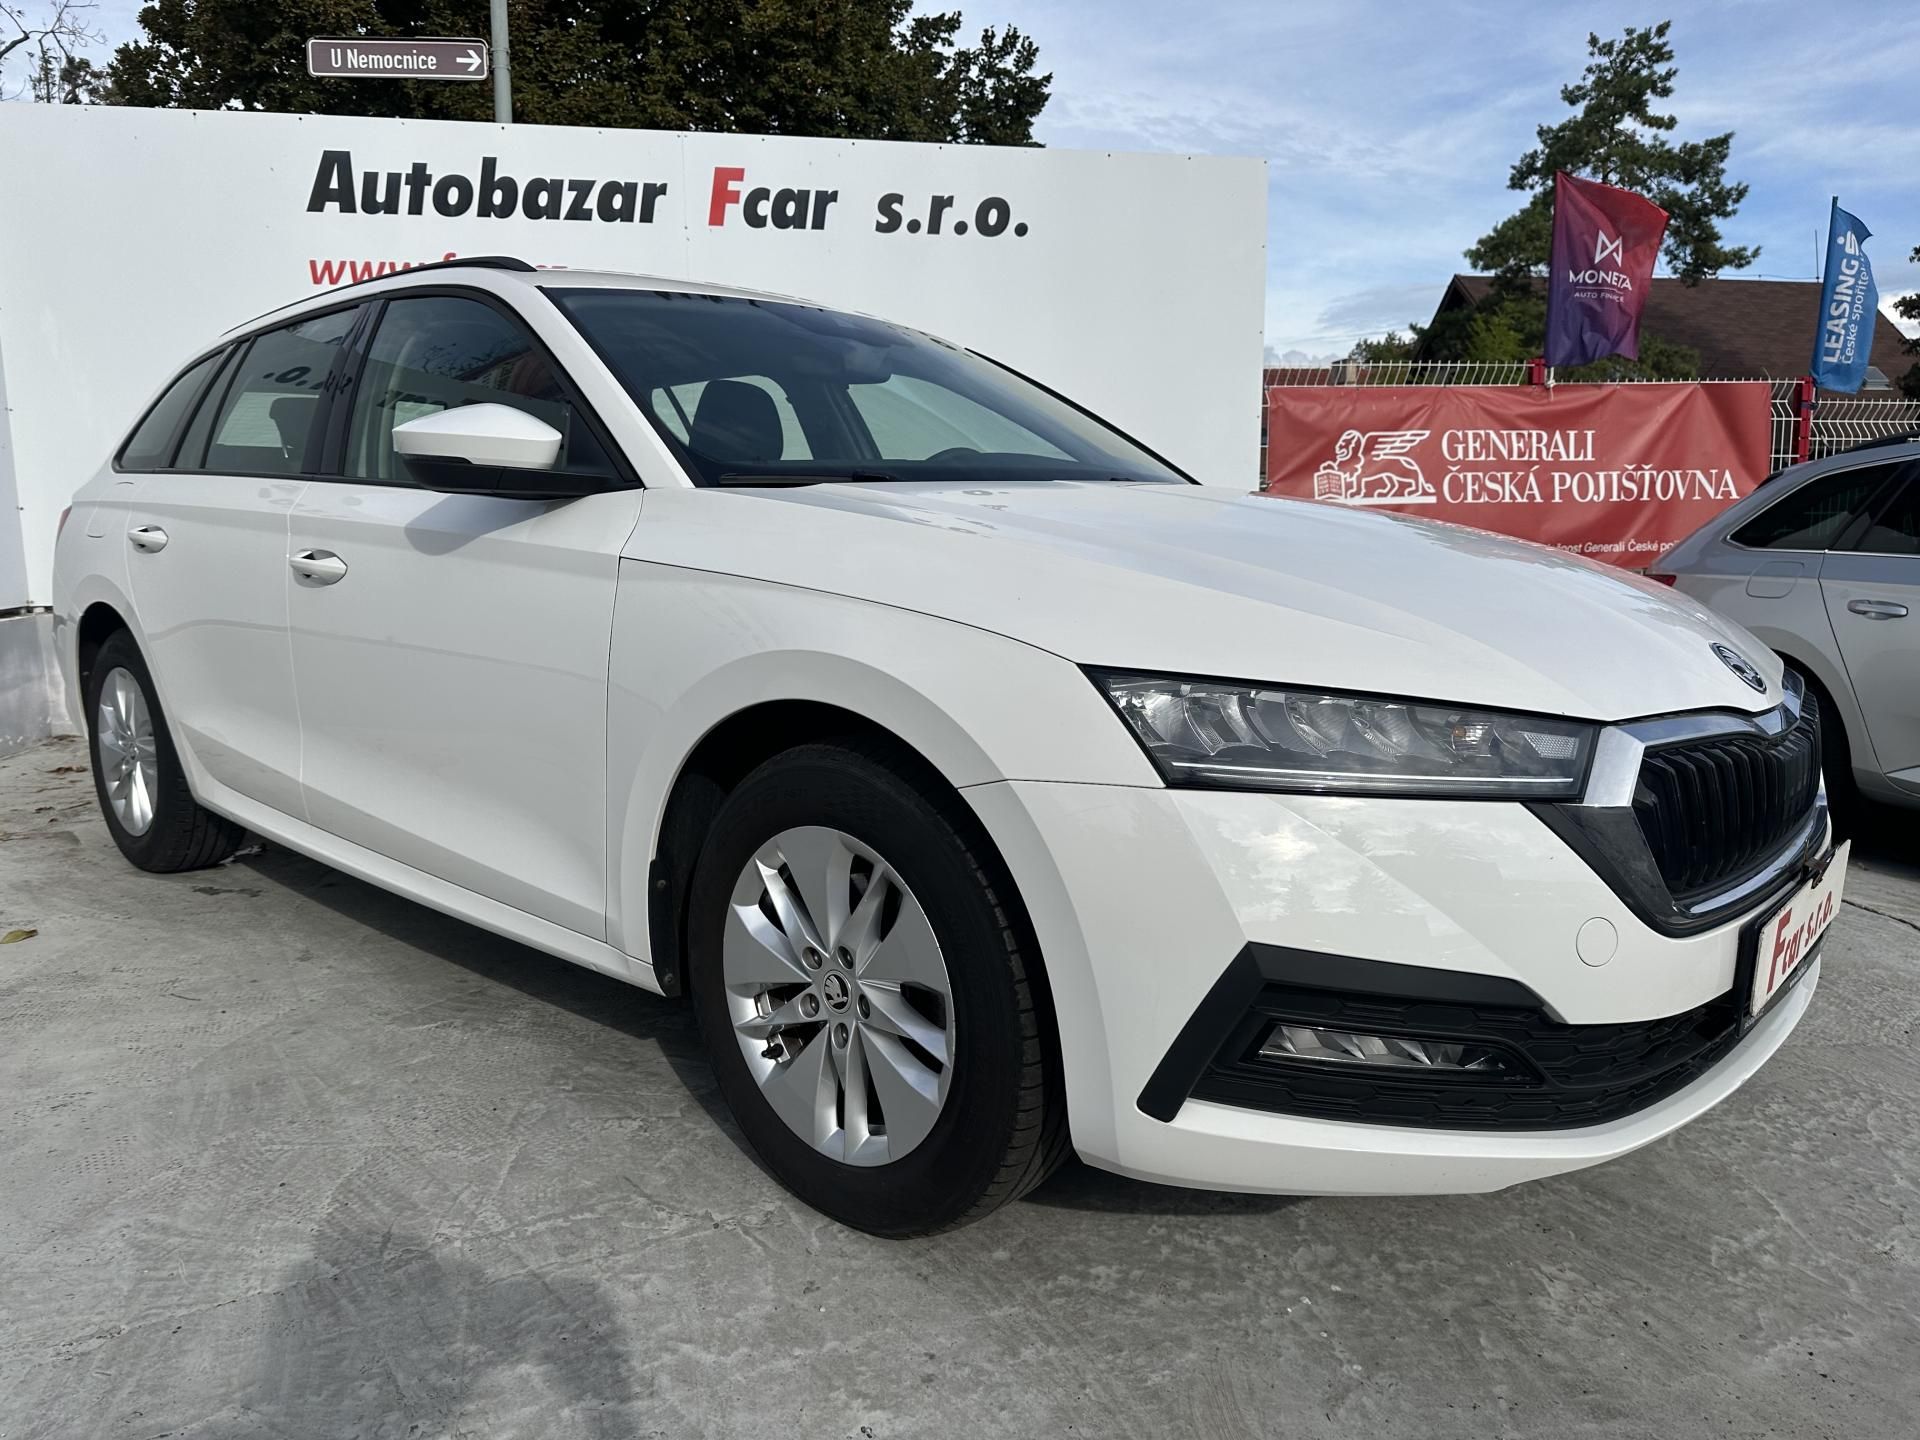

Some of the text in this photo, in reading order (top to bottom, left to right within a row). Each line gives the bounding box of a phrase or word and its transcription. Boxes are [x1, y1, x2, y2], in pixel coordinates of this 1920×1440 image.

[331, 48, 437, 71] U Nemocnice
[306, 149, 1029, 238] Autobazar Fcar s.r.o.
[1569, 269, 1632, 291] MONETA
[1823, 258, 1859, 363] LEASING
[1839, 323, 1858, 364] České
[1441, 429, 1596, 462] GENERALI
[1442, 463, 1741, 504] ČESKÁ POJIŠŤOVNA
[1584, 541, 1626, 553] Generali
[1627, 538, 1658, 552] České
